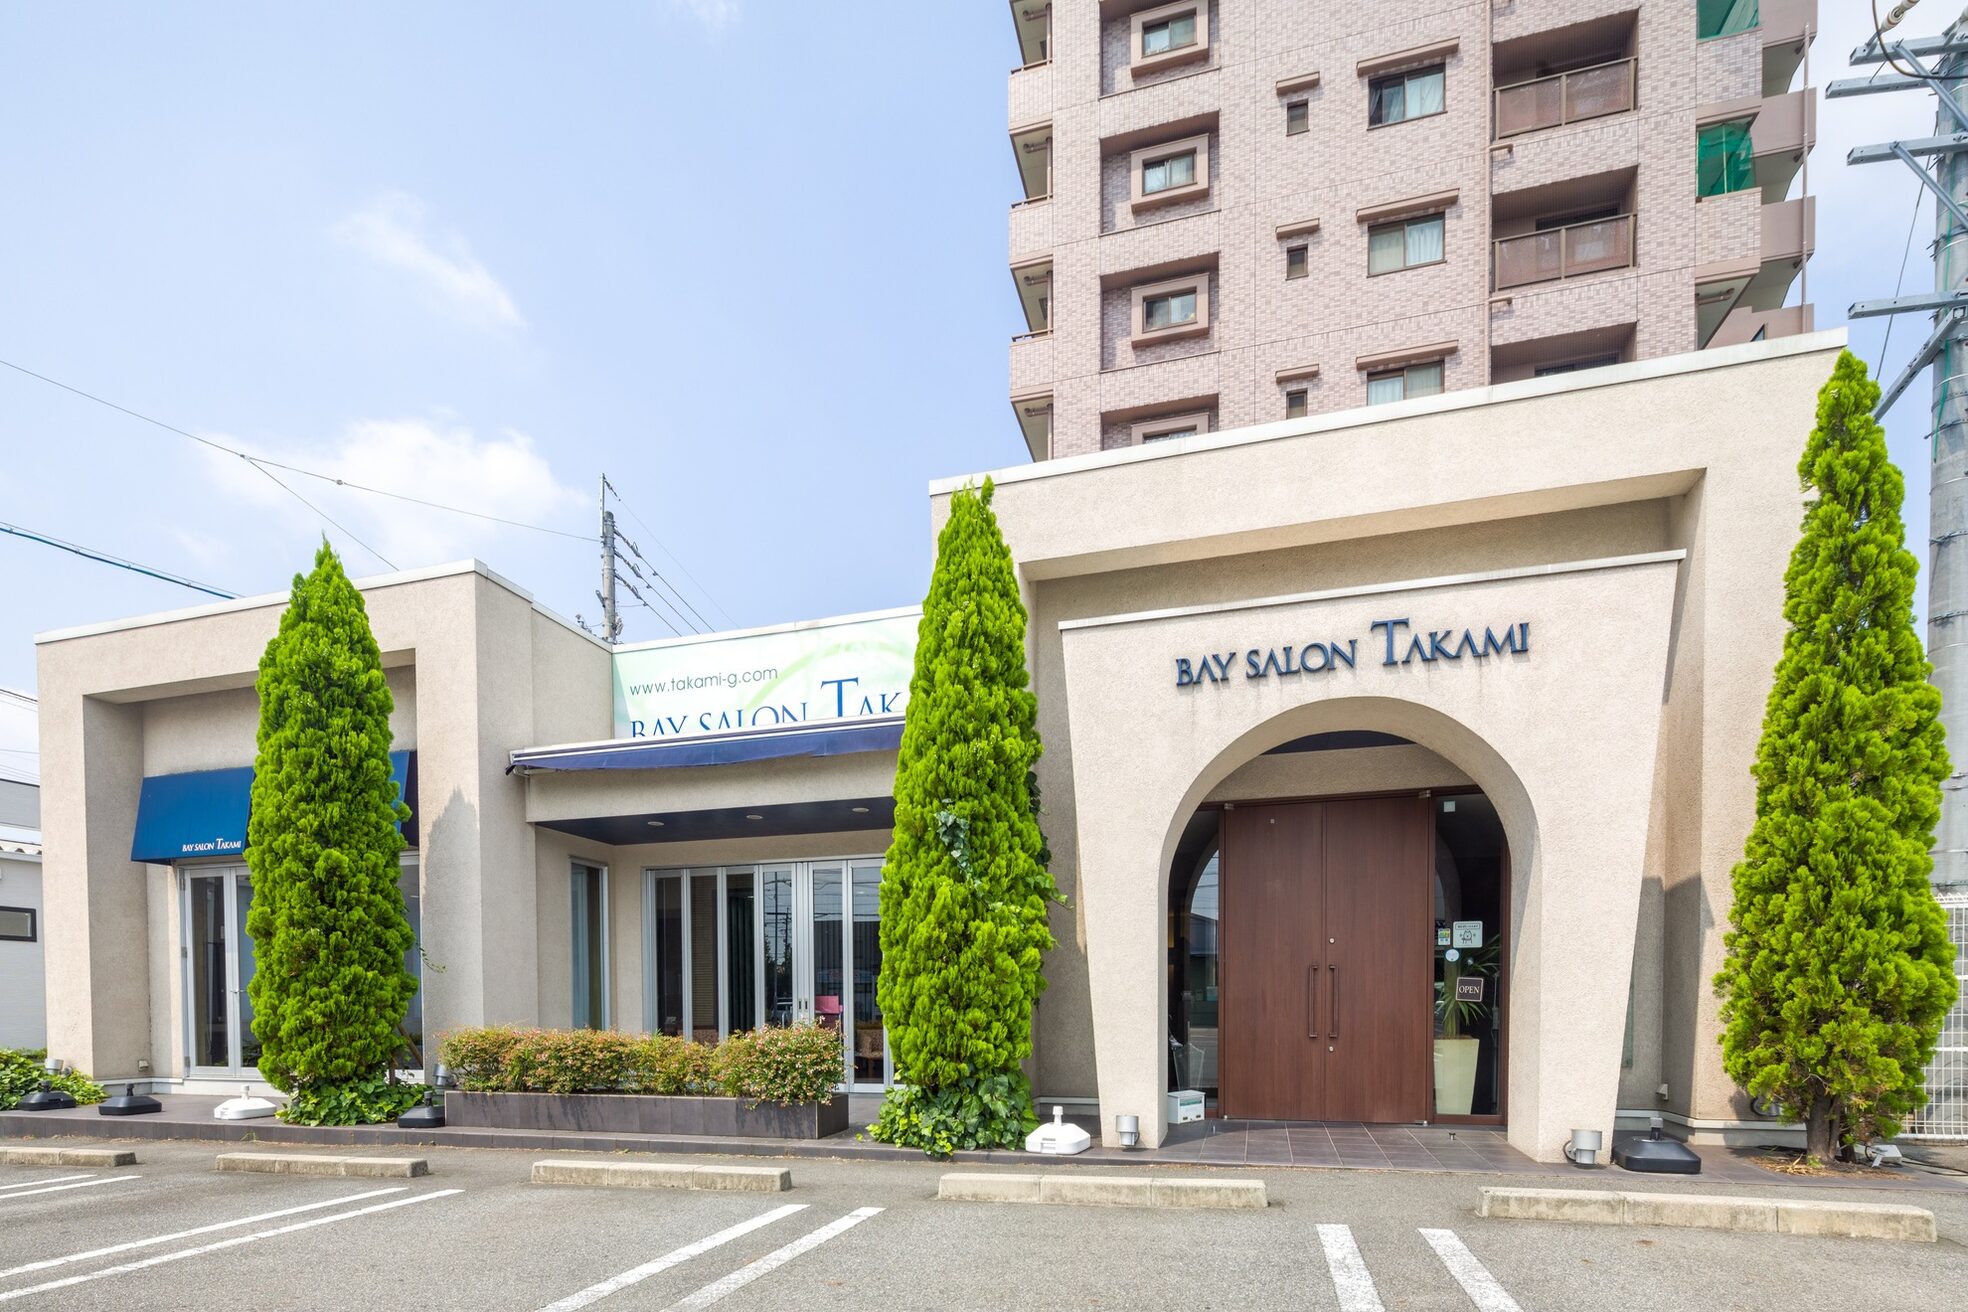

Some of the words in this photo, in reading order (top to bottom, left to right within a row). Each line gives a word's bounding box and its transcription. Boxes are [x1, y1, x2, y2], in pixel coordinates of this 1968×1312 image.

[1175, 651, 1236, 686] BAY
[1246, 638, 1358, 679] SALON
[1370, 617, 1530, 667] TAKAMI
[629, 667, 779, 696] www.takami-g.com
[820, 676, 903, 718] TAK
[182, 843, 195, 852] BAY
[194, 842, 215, 851] SALON
[216, 837, 242, 850] TAKAMI
[1458, 985, 1480, 994] OPEN
